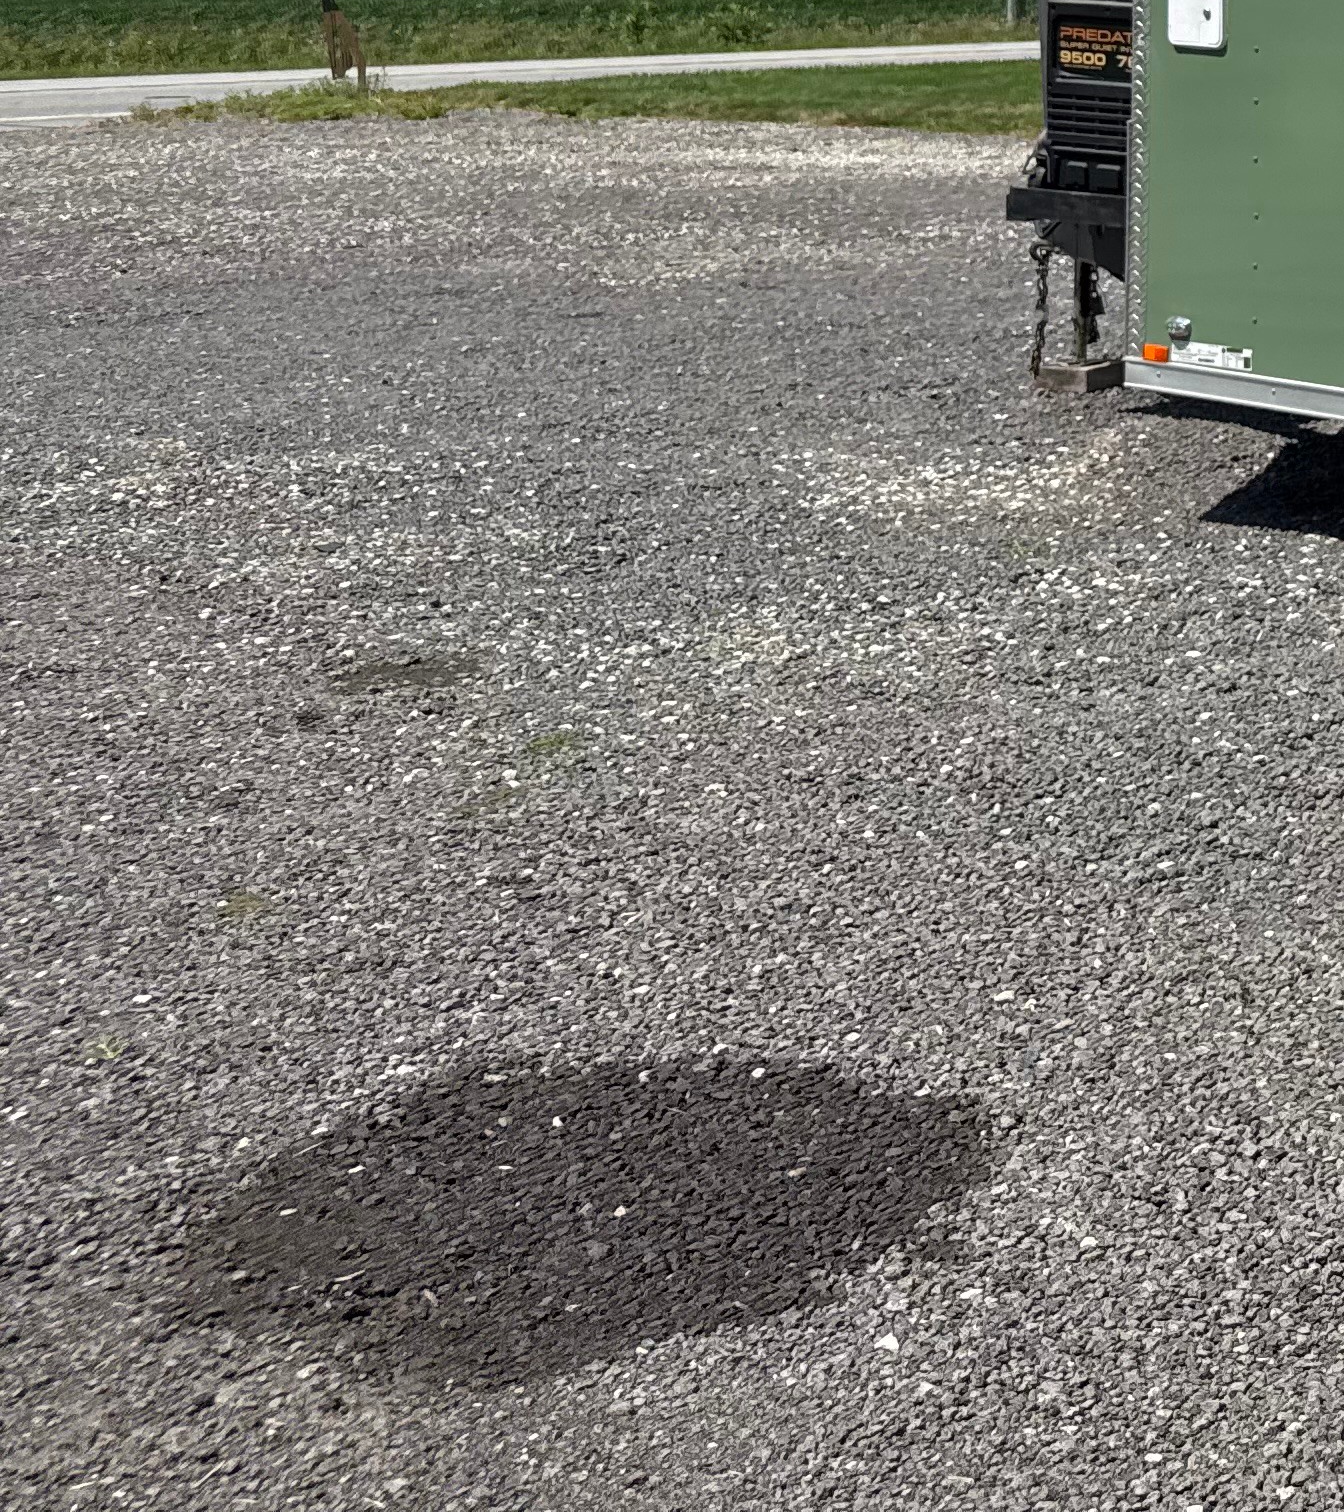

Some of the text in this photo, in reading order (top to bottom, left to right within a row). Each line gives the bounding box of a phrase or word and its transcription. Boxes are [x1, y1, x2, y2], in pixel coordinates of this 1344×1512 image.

[1060, 40, 1089, 50] SUPER
[1091, 43, 1117, 52] QUIET
[1060, 50, 1107, 66] 9500
